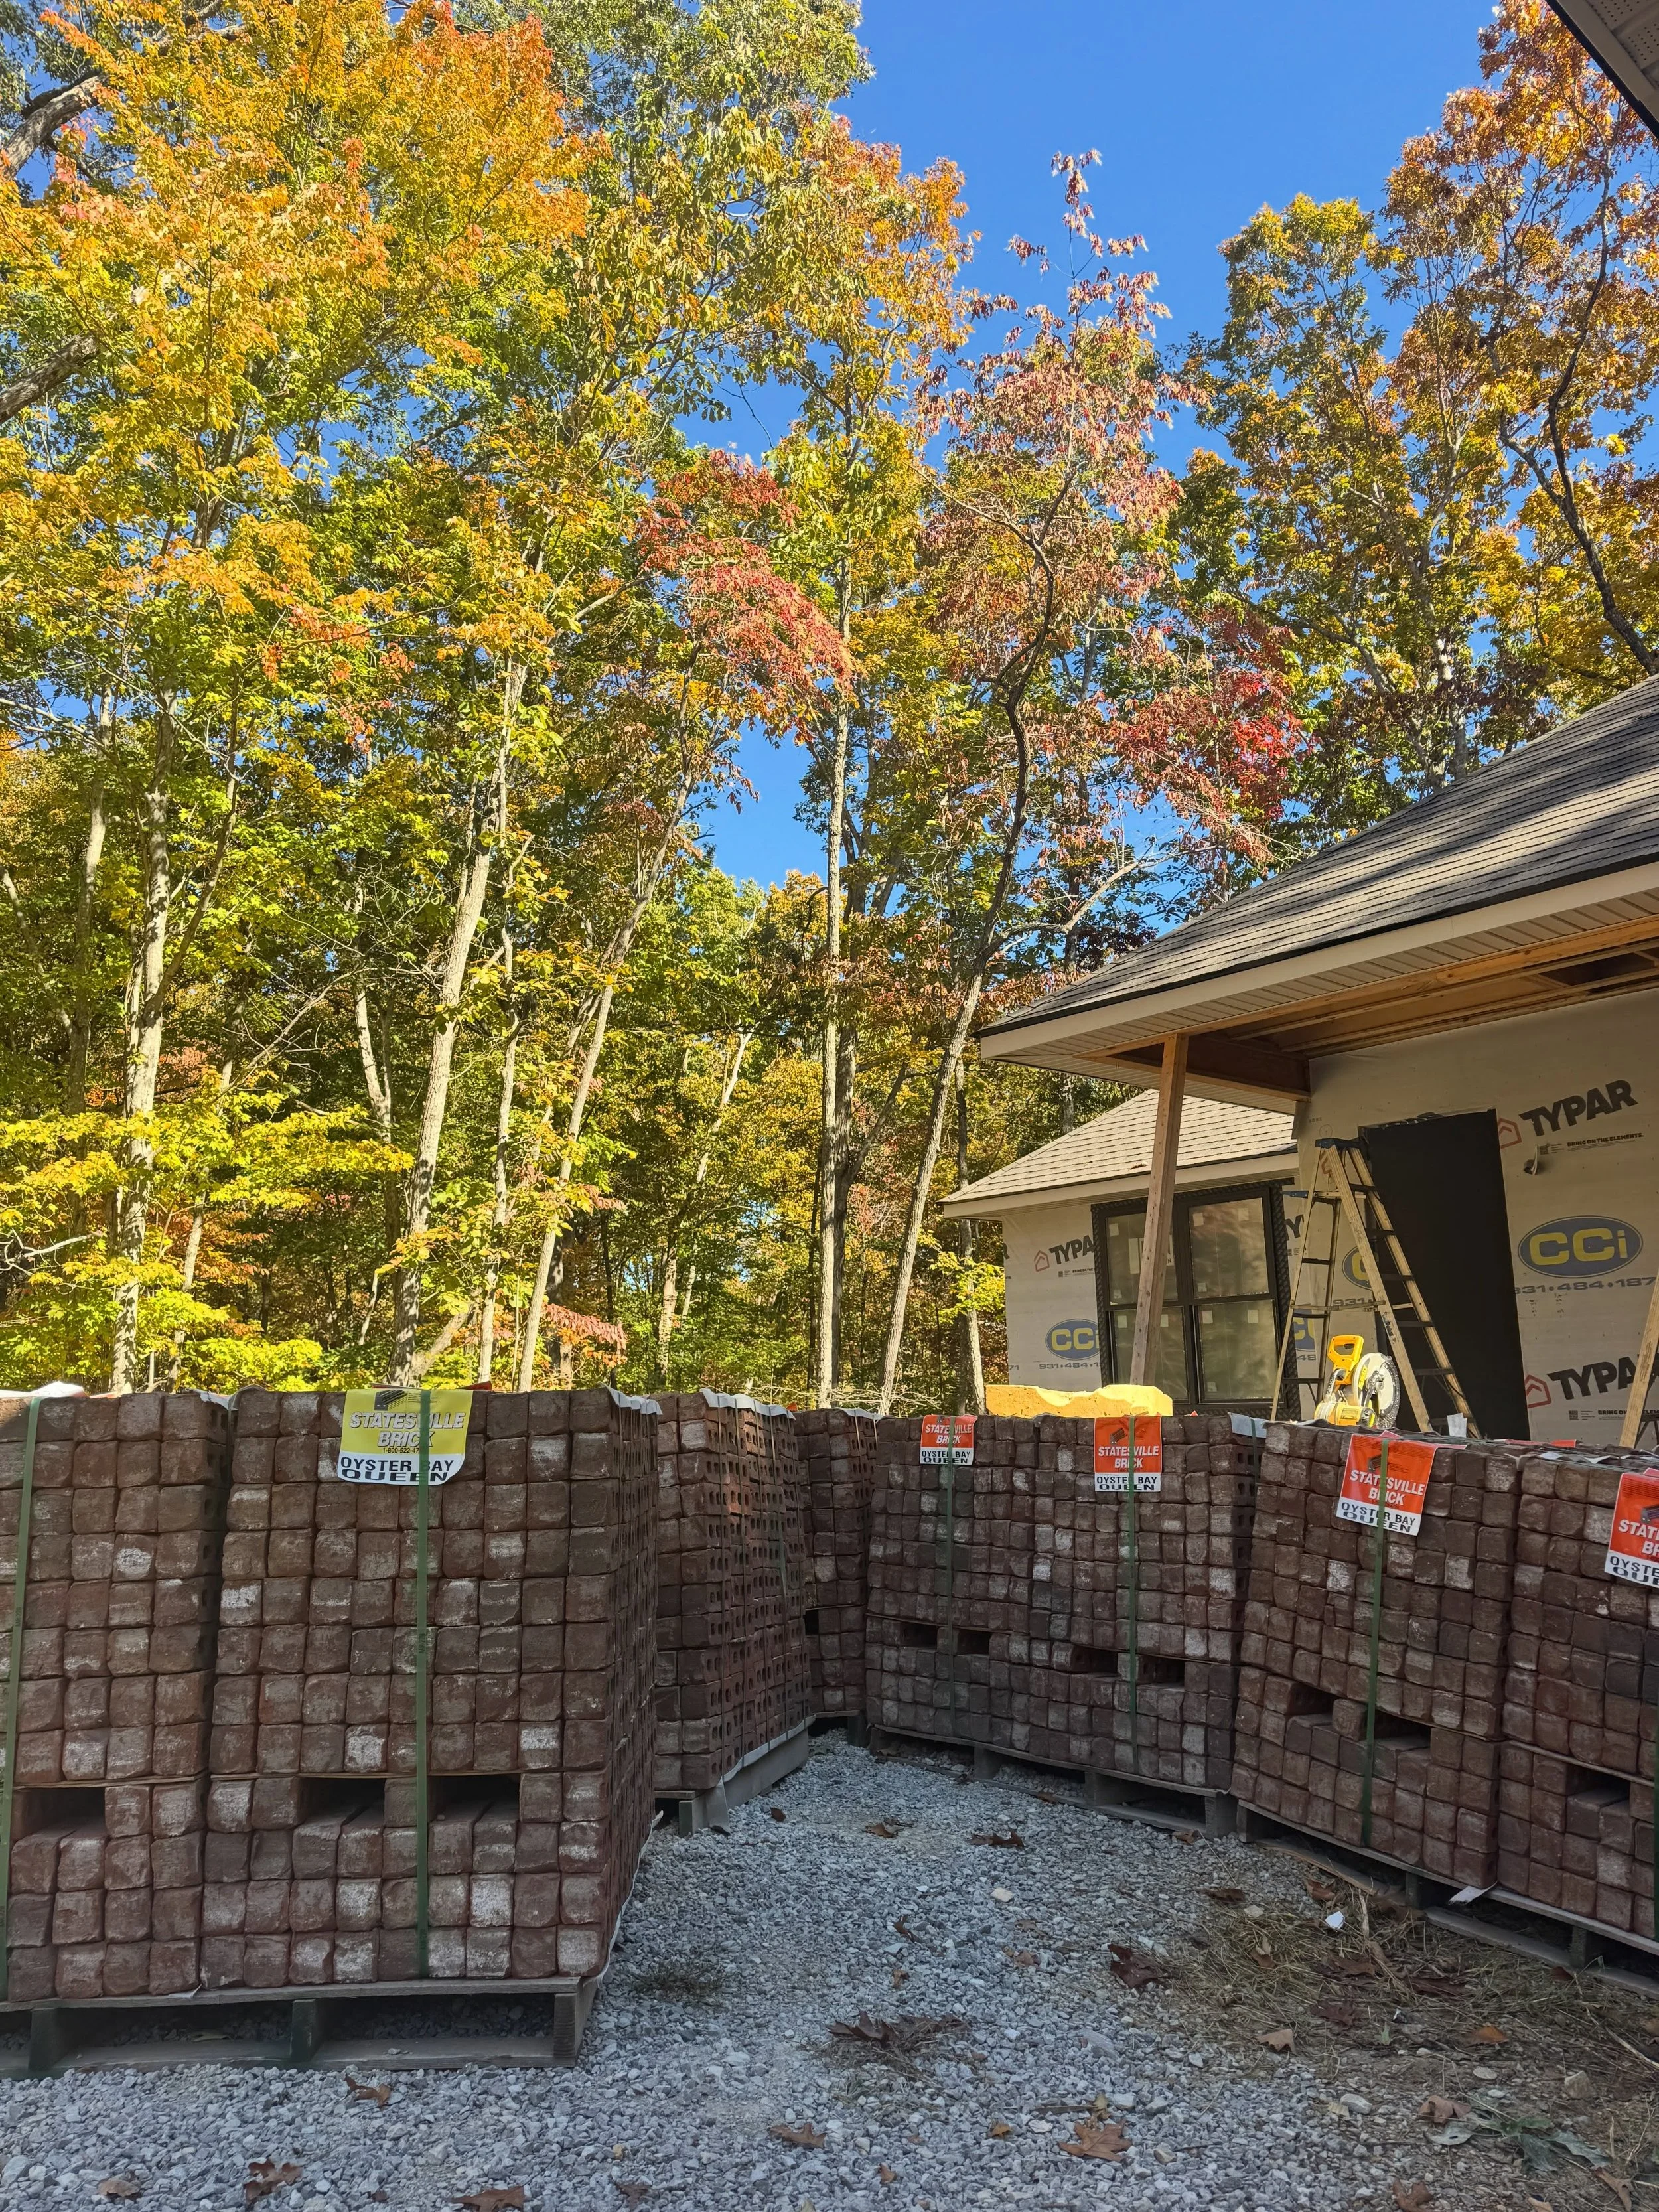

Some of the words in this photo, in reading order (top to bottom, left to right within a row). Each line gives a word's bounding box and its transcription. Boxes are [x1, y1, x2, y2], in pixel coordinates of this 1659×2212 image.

[1518, 1080, 1638, 1136] TYPAR
[1529, 1228, 1628, 1266] CCi
[1547, 1353, 1659, 1400] TYPA
[350, 1412, 465, 1429] STATESILLE
[925, 1424, 972, 1434] STATEVILLE
[340, 1457, 411, 1471] OYSTER
[341, 1469, 448, 1482] QUEEN
[1350, 1469, 1425, 1495] STATSVILLE
[1395, 1514, 1415, 1526] BAY
